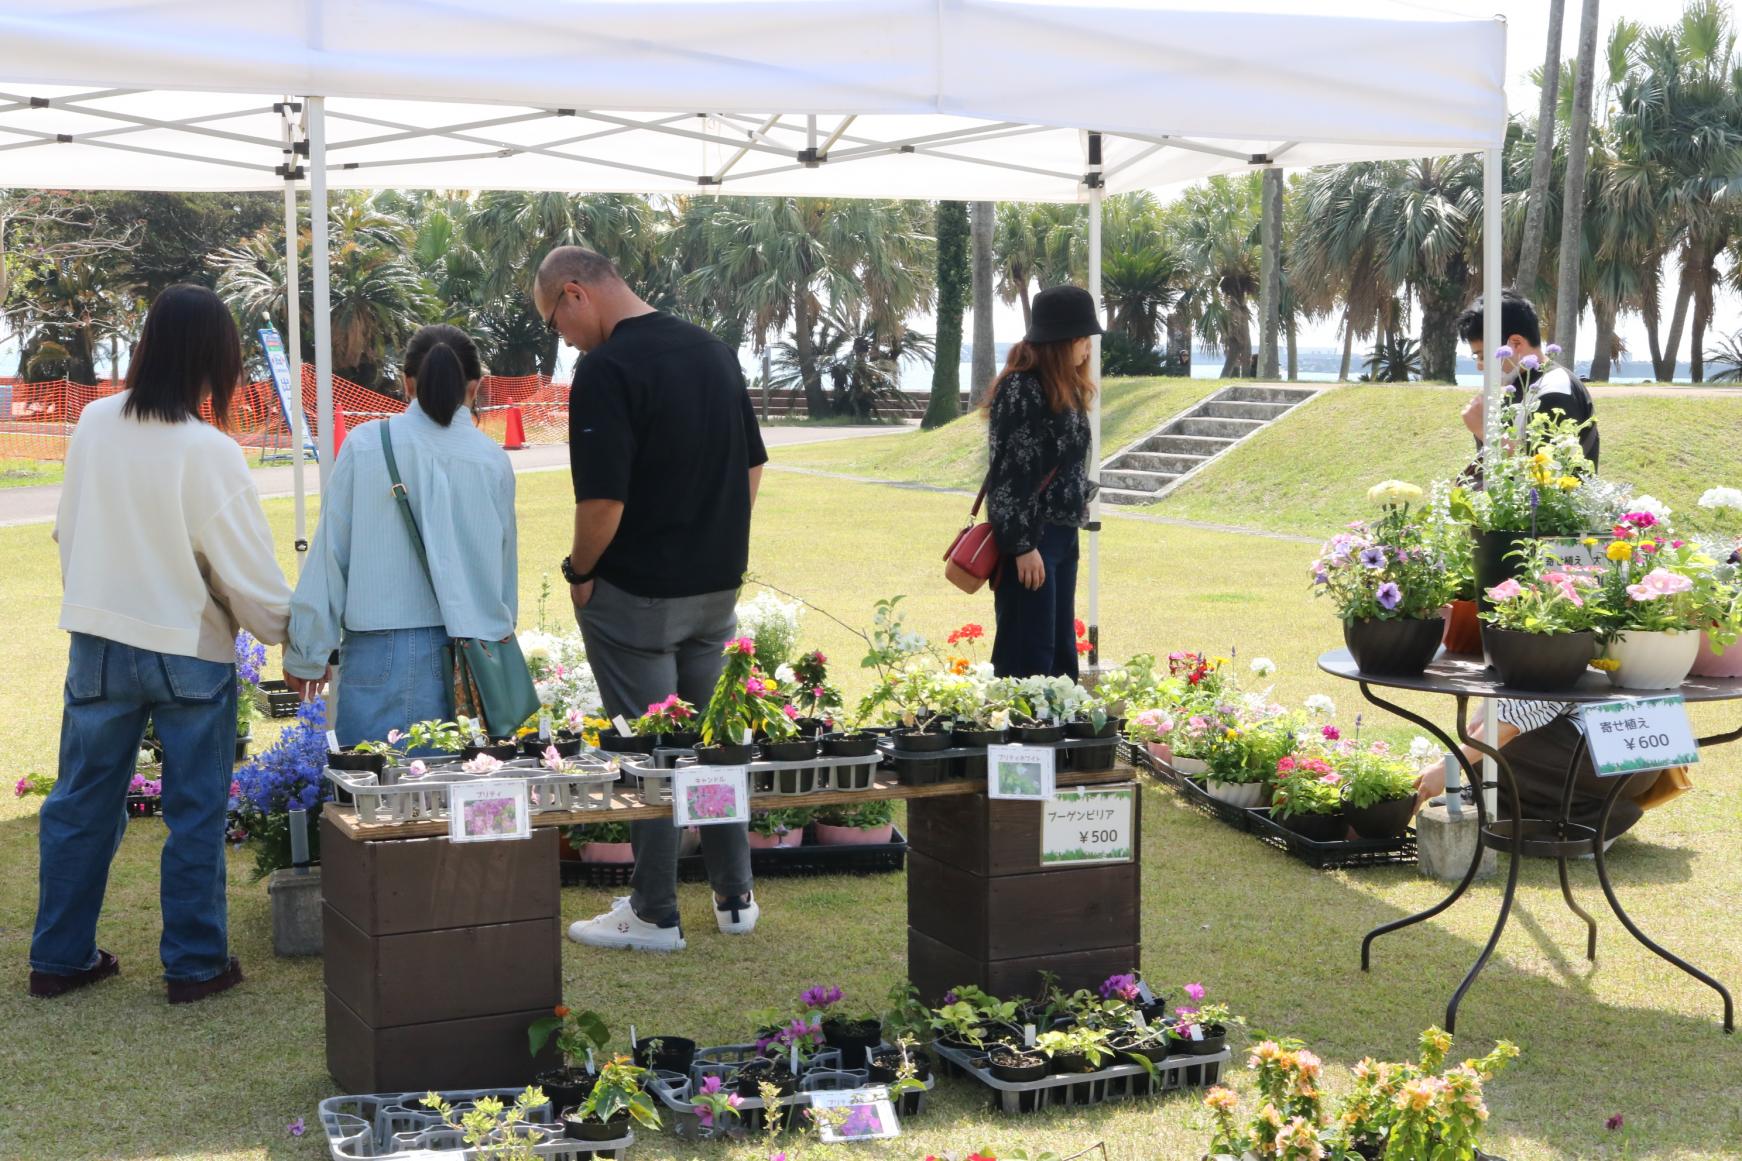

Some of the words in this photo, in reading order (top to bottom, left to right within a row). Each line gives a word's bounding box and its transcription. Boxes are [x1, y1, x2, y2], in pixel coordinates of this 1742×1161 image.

[1600, 717, 1650, 733] 寄せ植え
[1623, 733, 1670, 750] ¥600
[1079, 829, 1118, 844] ¥500
